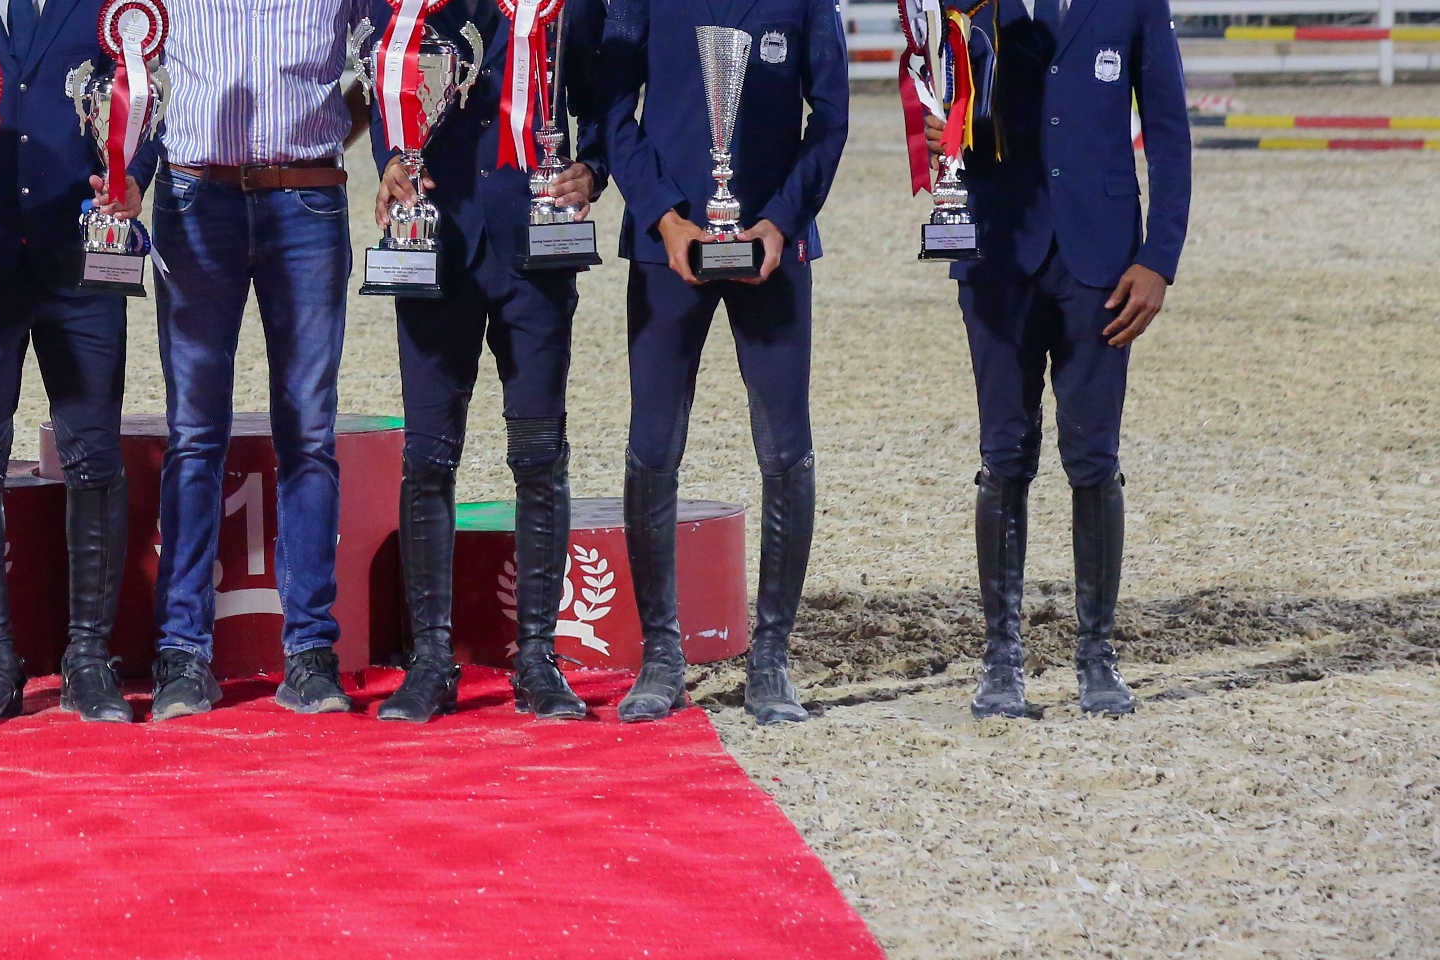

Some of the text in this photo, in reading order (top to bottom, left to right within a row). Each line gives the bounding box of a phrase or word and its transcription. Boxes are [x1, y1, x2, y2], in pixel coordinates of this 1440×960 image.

[390, 39, 403, 72] FIRST
[516, 57, 526, 93] FIRST
[224, 472, 266, 576] 1
